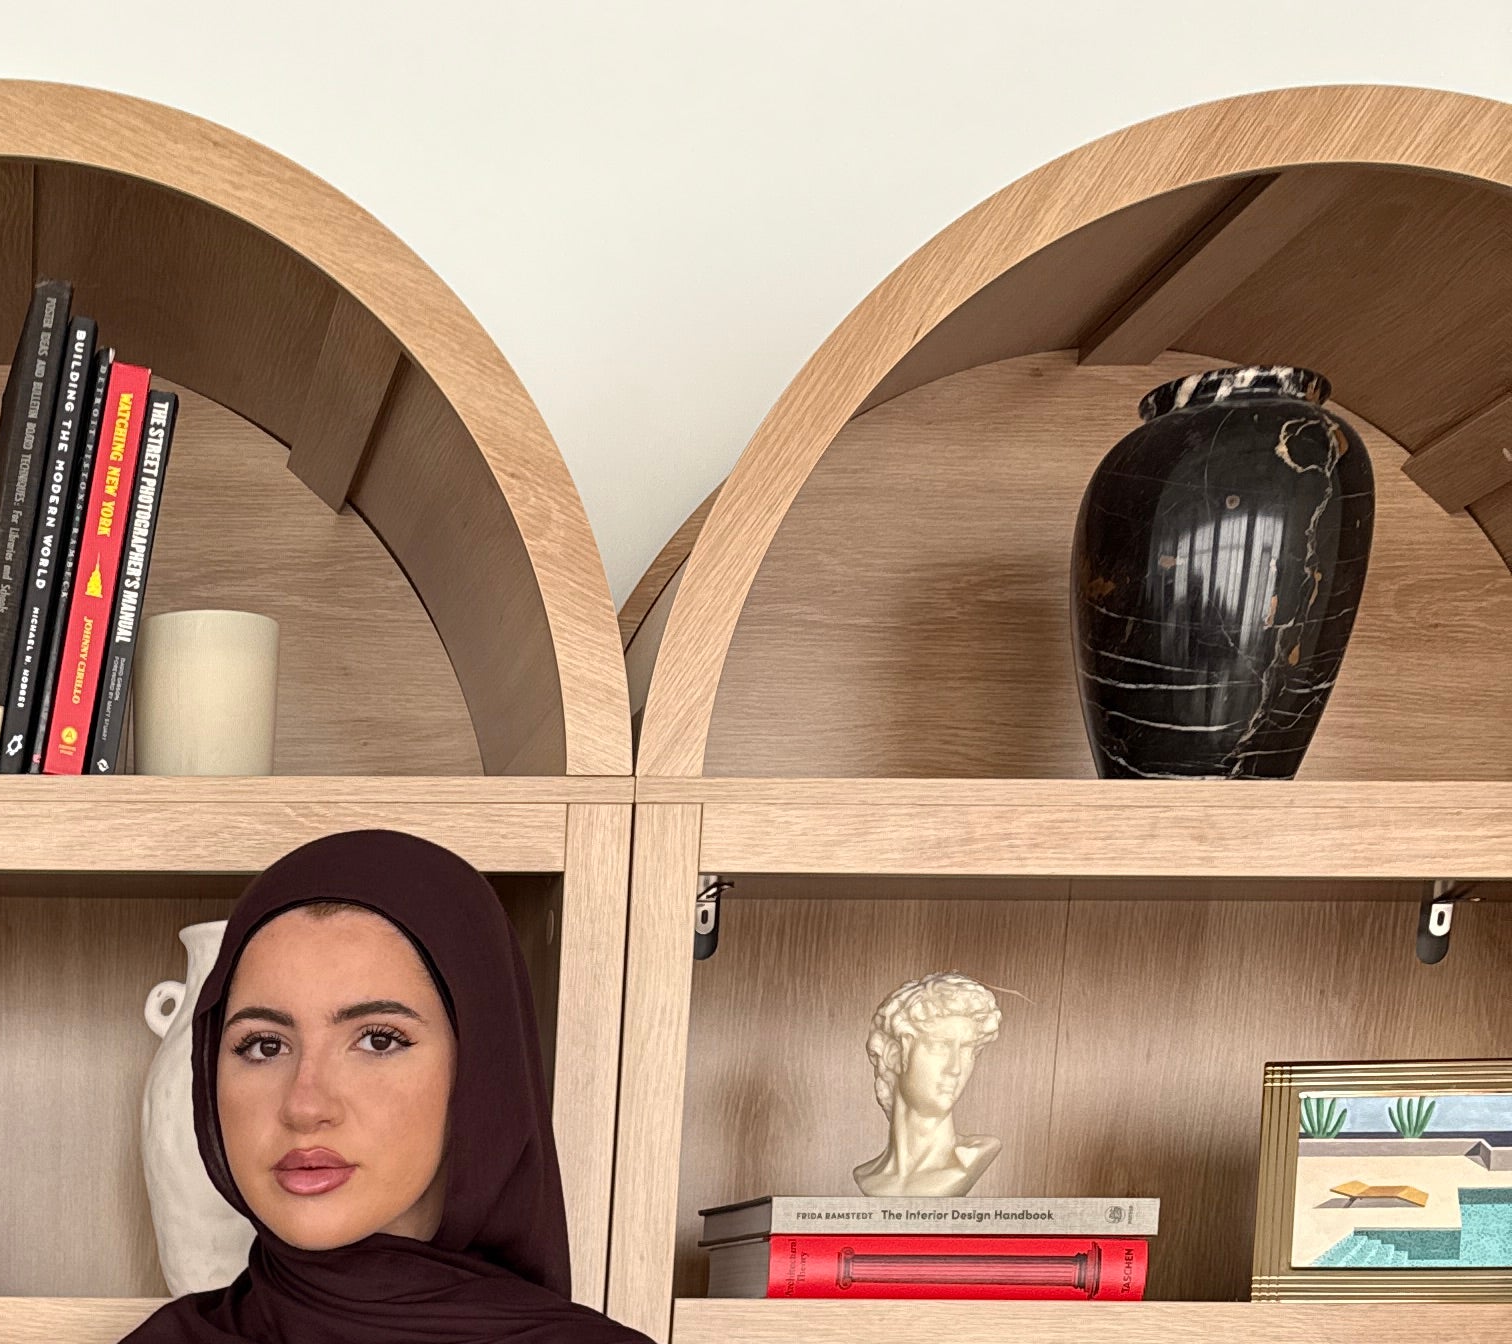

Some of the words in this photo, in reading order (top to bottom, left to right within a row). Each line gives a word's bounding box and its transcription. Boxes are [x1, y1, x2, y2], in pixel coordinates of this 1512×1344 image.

[34, 359, 47, 378] AND
[64, 329, 87, 412] BUILDING
[28, 381, 44, 419] BULLETIN
[88, 364, 108, 437] DETROIT
[152, 400, 170, 431] THE
[57, 420, 73, 453] THE
[109, 392, 134, 462] WATCHING
[142, 426, 165, 477] STREET
[45, 460, 66, 528] MODERN
[104, 465, 122, 497] NEW
[10, 509, 23, 525] For
[97, 500, 116, 538] YORK
[123, 475, 158, 593] PHOTOGRAPHER'S
[4, 527, 20, 562] Libraries
[35, 534, 54, 589] WORLD
[2, 563, 13, 581] and
[25, 606, 40, 652] MICHAEL
[115, 589, 139, 643] MANUAL
[78, 616, 94, 663] JOHNNY
[71, 662, 87, 705] CIRILLO
[796, 1212, 823, 1220] FRIDA
[825, 1212, 875, 1220] RAMSTEDT
[881, 1210, 903, 1220] The
[905, 1210, 948, 1220] Interior
[951, 1210, 991, 1222] Design
[994, 1210, 1054, 1221] Handbook
[1121, 1248, 1134, 1293] TASCHEN
